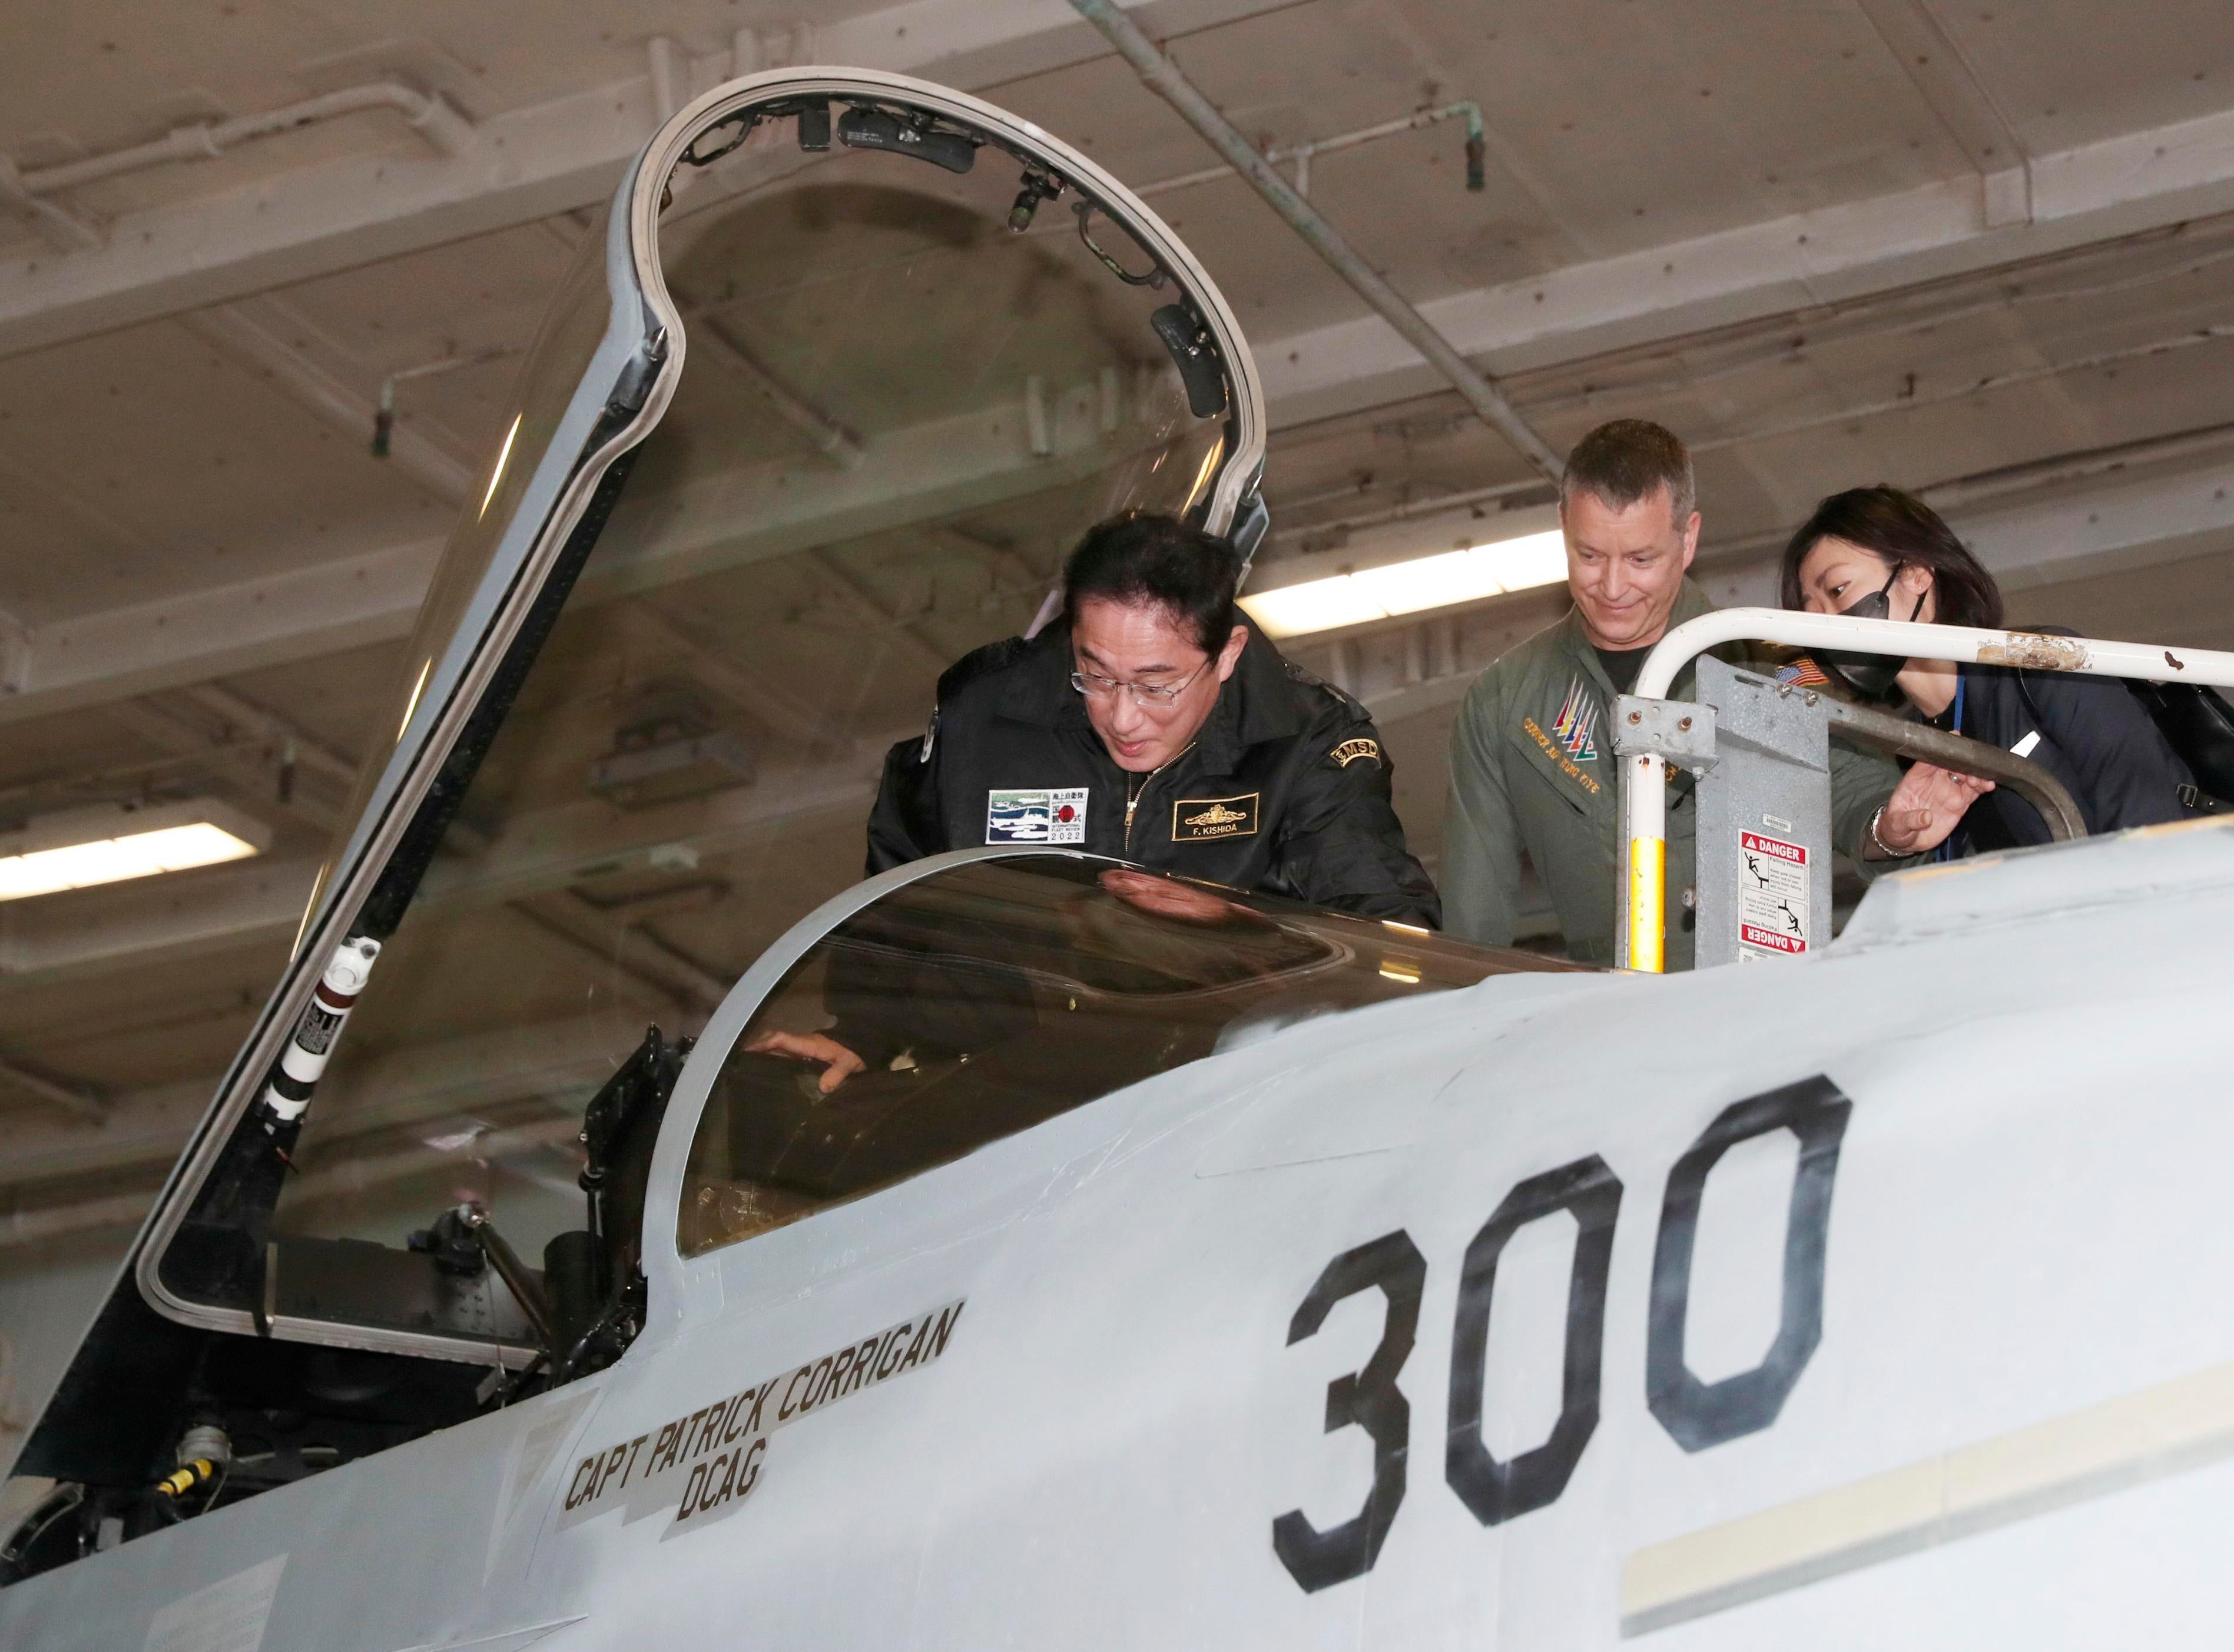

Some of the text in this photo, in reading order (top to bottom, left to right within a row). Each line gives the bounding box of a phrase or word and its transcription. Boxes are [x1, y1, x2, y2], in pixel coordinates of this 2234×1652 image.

[1560, 758, 1580, 777] WING
[1579, 774, 1600, 793] FIVE
[1051, 832, 1080, 840] 2022
[1203, 824, 1237, 835] KISHIDA
[1759, 839, 1799, 861] DANGER
[1769, 857, 1785, 866] Falling
[1747, 927, 1788, 949] DANGER
[1761, 923, 1776, 931] Falling
[1273, 1073, 1853, 1594] 300
[565, 1301, 964, 1511] CAPT PATRICK CORRIGAN
[677, 1438, 765, 1521] DCAG
